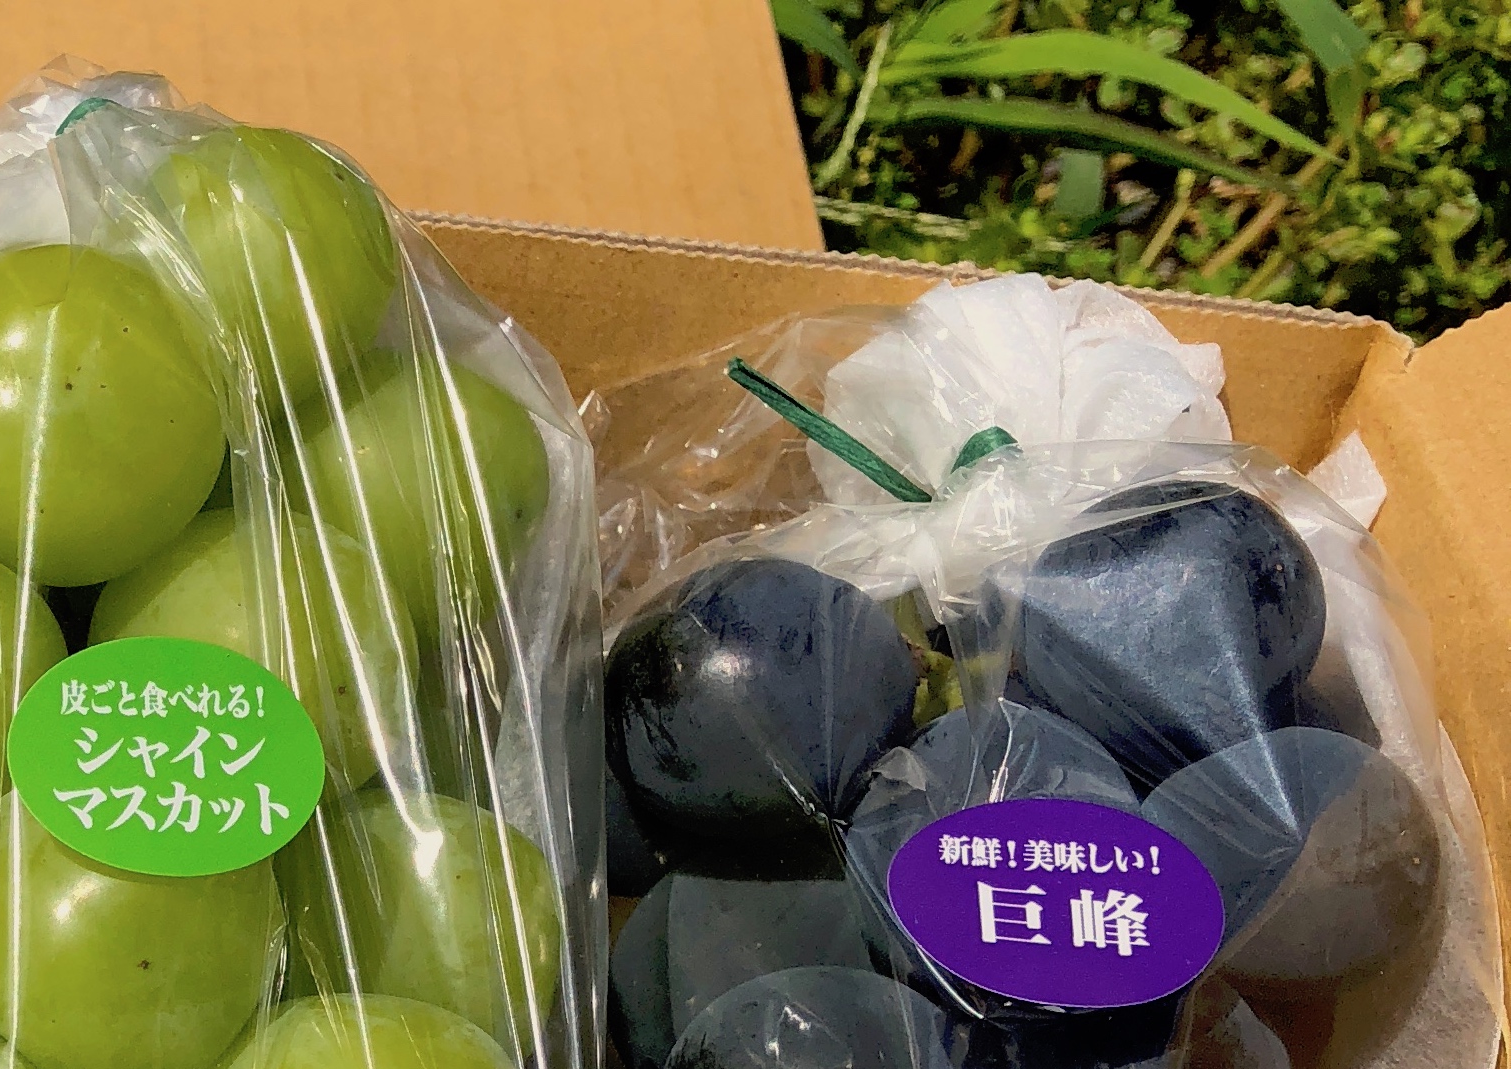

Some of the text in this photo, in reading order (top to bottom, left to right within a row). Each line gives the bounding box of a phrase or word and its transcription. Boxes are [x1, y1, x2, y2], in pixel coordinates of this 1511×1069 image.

[60, 679, 265, 719] 皮ごと食べれる！
[74, 725, 266, 779] シャイン
[52, 781, 290, 836] マスカット
[938, 833, 1161, 876] 新鮮！美味しい！
[976, 880, 1151, 957] 巨峰
